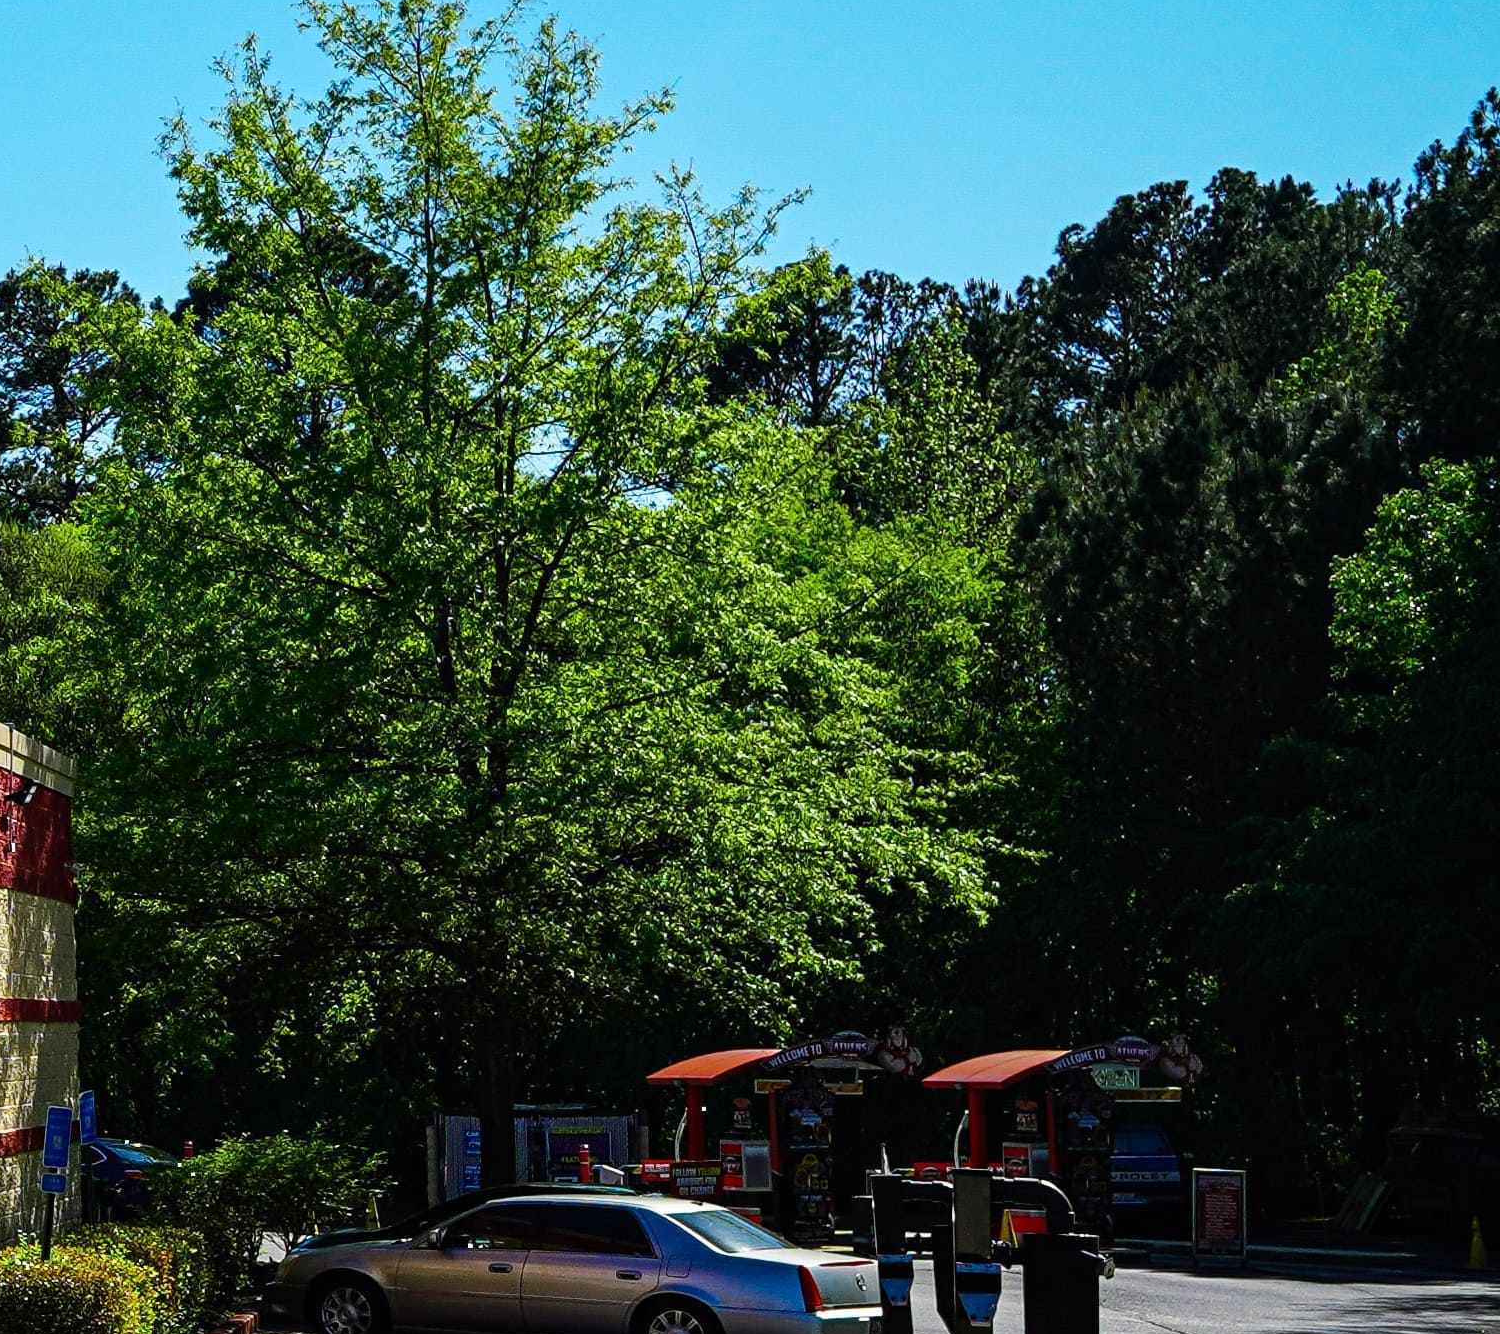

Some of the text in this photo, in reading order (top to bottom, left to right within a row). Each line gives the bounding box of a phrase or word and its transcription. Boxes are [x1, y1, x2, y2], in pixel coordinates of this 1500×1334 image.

[767, 1045, 811, 1068] WELCOME
[811, 1042, 823, 1057] TO
[1053, 1049, 1094, 1071] WELCOME
[1094, 1047, 1106, 1060] TO
